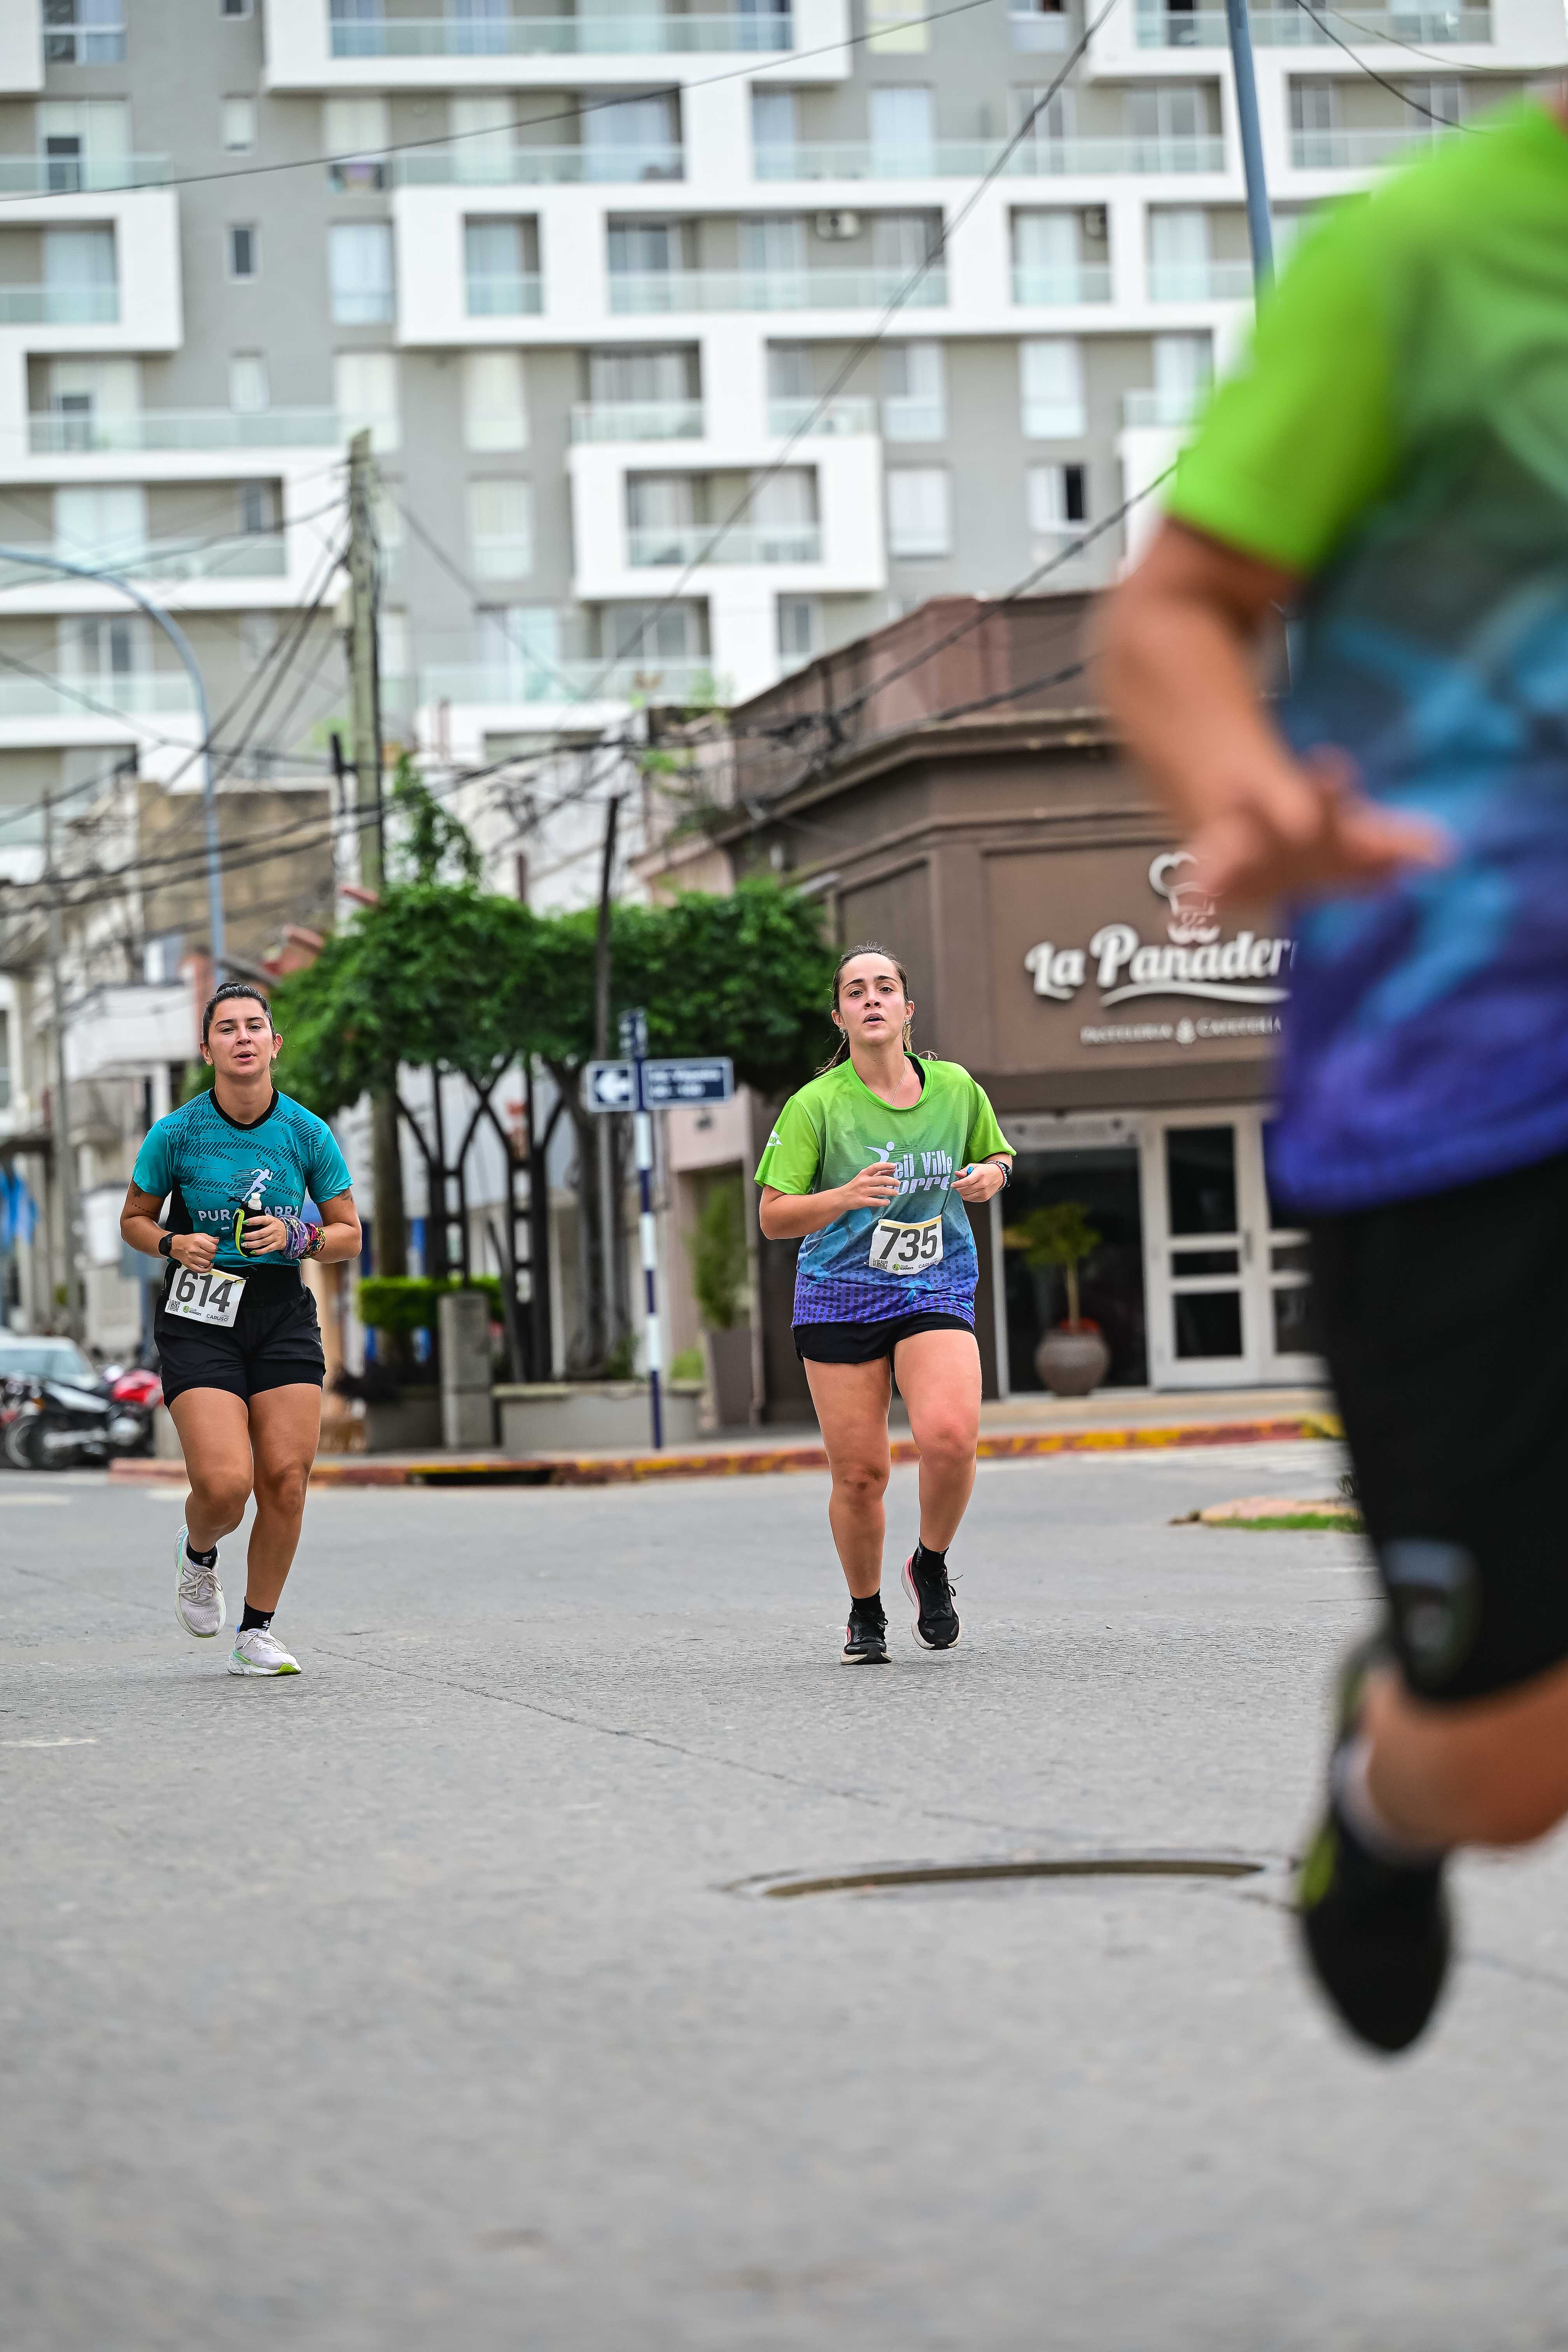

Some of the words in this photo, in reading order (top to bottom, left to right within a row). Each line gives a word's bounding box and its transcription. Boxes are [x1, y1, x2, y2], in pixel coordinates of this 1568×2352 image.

[1024, 942, 1086, 1000] La
[893, 1153, 914, 1179] ell
[920, 1150, 952, 1176] Ville
[886, 1175, 950, 1195] orre
[879, 1223, 938, 1262] 735
[175, 1269, 233, 1313] 614
[206, 1314, 228, 1322] CARUSO
